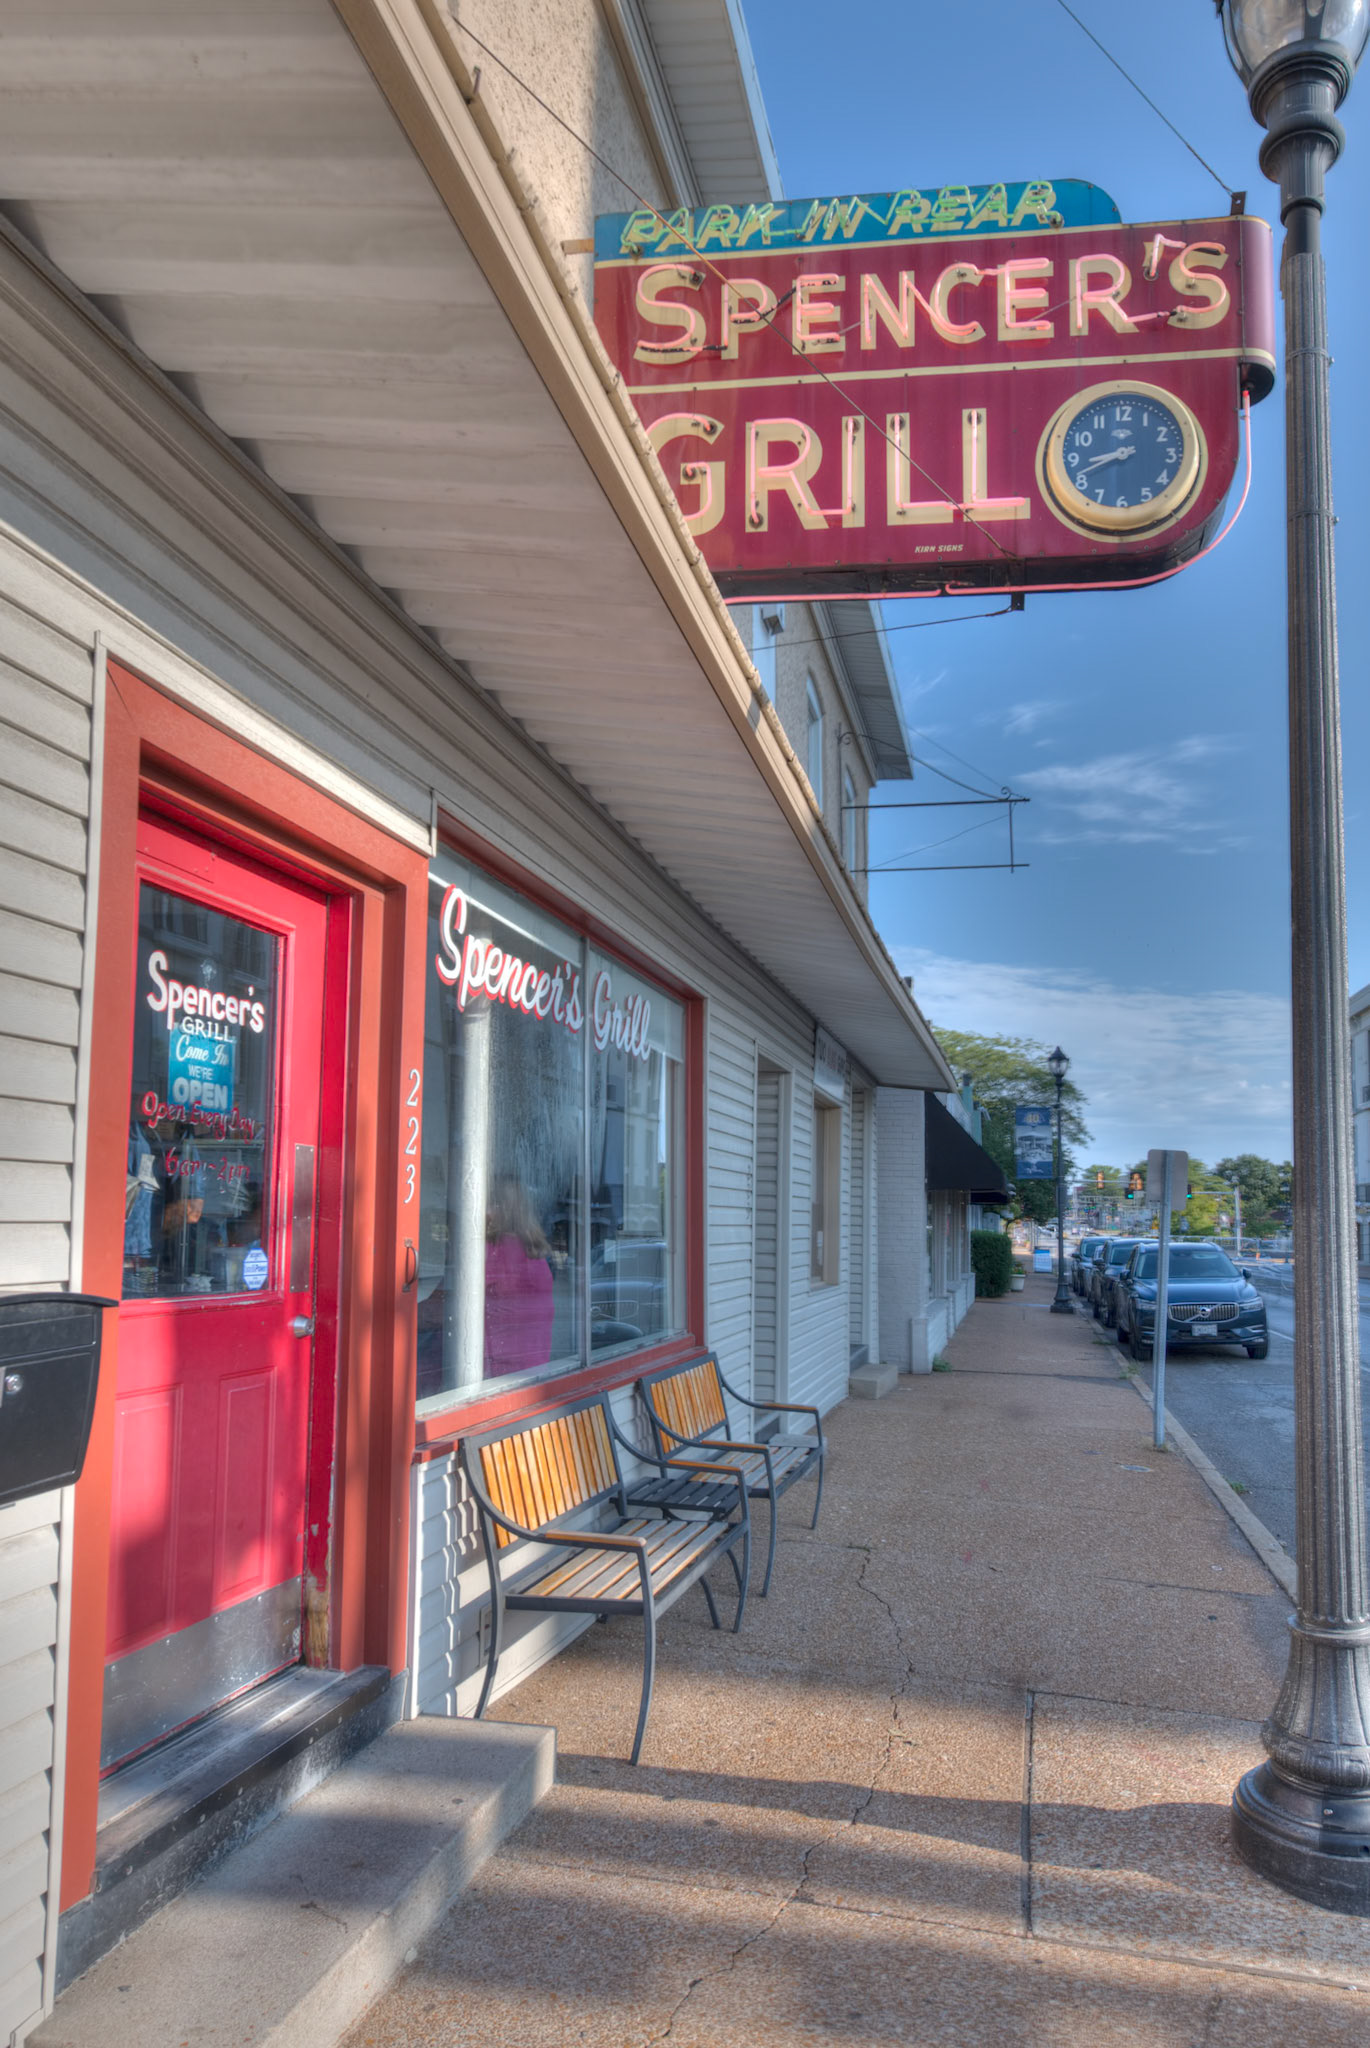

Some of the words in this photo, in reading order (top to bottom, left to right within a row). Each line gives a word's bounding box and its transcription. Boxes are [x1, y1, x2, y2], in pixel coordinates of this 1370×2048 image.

[619, 203, 786, 254] PARK
[802, 196, 870, 242] IN
[887, 180, 1061, 236] REAR
[633, 233, 1230, 366] SPENCER'S
[1093, 414, 1105, 430] 11
[1115, 405, 1133, 422] 12
[1143, 411, 1149, 427] 1
[1075, 430, 1093, 447] 10
[1155, 426, 1169, 443] 2
[1067, 452, 1080, 468] 9
[1165, 447, 1178, 464] 3
[645, 407, 1031, 538] GRILL
[1155, 468, 1170, 486] 4
[1075, 473, 1089, 491] 8
[1094, 488, 1105, 504] 7
[1140, 487, 1153, 503] 5
[937, 543, 964, 553] SIGNS
[435, 884, 584, 1034] Spencer's
[594, 971, 651, 1061] Grill
[146, 949, 265, 1034] Spencer's
[181, 1016, 234, 1043] GRILL
[175, 1034, 209, 1062] Come
[210, 1043, 230, 1067] In
[172, 1076, 228, 1111] OPEN
[141, 1090, 187, 1129] Open
[189, 1100, 227, 1142] Every
[228, 1106, 256, 1145] Day
[404, 1068, 421, 1204] 223
